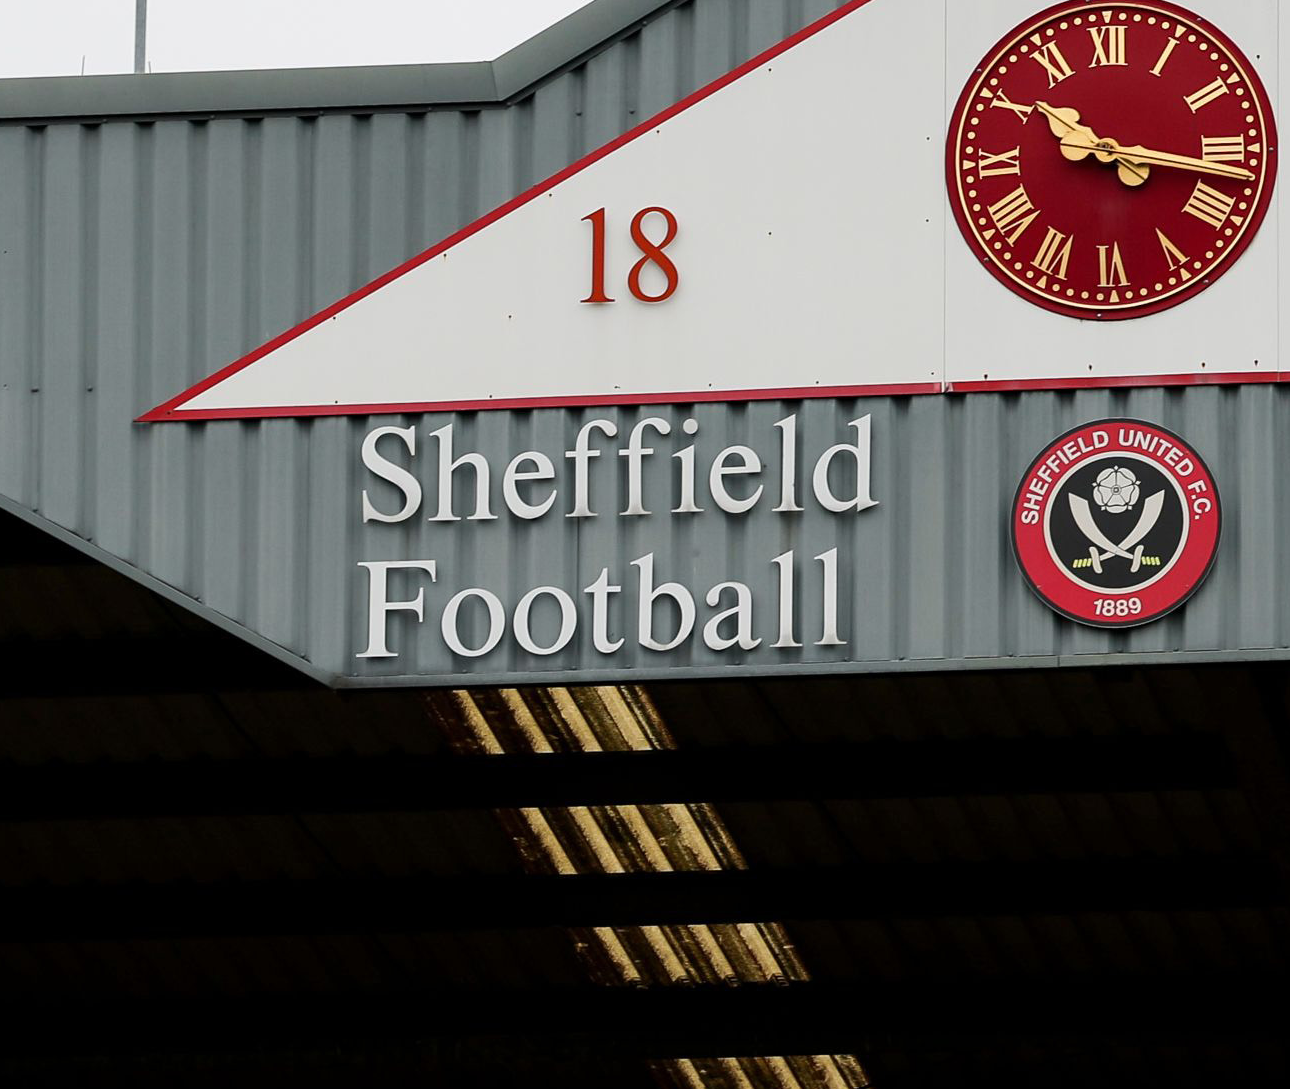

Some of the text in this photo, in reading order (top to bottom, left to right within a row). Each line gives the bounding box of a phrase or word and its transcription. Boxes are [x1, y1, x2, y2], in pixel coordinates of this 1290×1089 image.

[1029, 40, 1076, 90] XI
[1086, 25, 1128, 68] XII
[1149, 36, 1180, 77] I
[990, 88, 1035, 124] X
[1183, 76, 1230, 114] II
[978, 145, 1021, 180] IX
[1201, 133, 1245, 163] III
[987, 182, 1042, 248] VIII
[1181, 178, 1237, 231] IIII
[580, 206, 679, 303] 18
[1030, 225, 1073, 281] VII
[1095, 240, 1131, 287] VI
[1155, 227, 1191, 272] V
[361, 413, 880, 524] Sheffield
[1020, 428, 1213, 525] SHEFFIELD UNITED F.C.
[355, 546, 848, 659] Football
[1093, 597, 1142, 617] 1889
